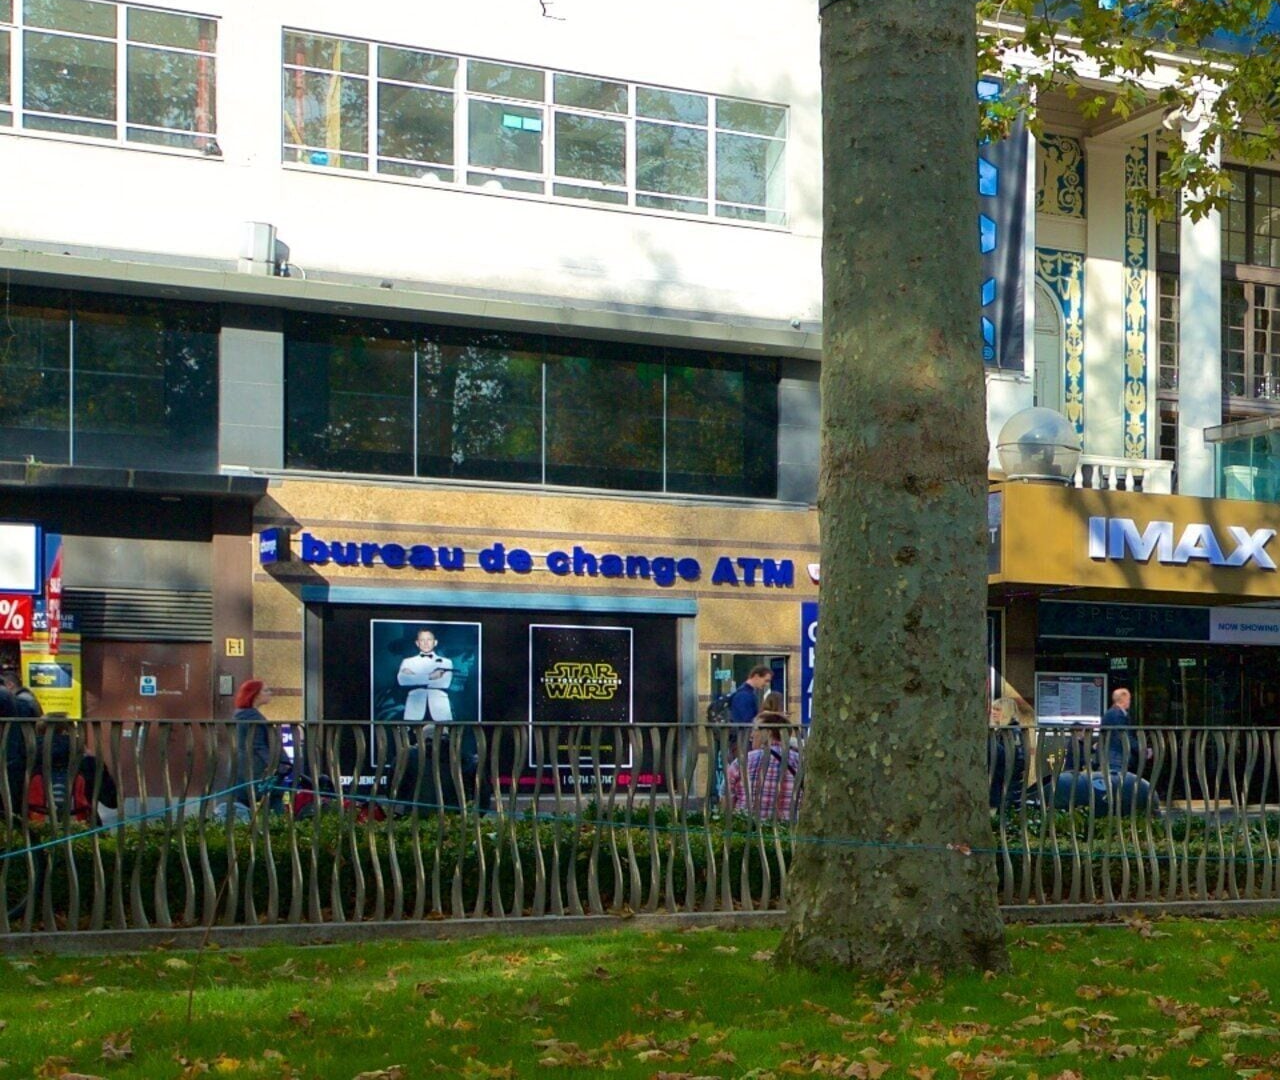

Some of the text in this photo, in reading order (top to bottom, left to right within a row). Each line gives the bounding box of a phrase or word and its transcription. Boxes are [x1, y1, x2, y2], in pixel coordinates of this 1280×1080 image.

[1089, 517, 1277, 569] IMAX
[301, 532, 795, 588] bureau de change ATM
[1077, 606, 1173, 622] SPECTRE
[1218, 622, 1238, 631] NOW
[1239, 622, 1279, 633] SHOWING
[544, 662, 618, 680] STAR
[544, 683, 619, 701] WARS
